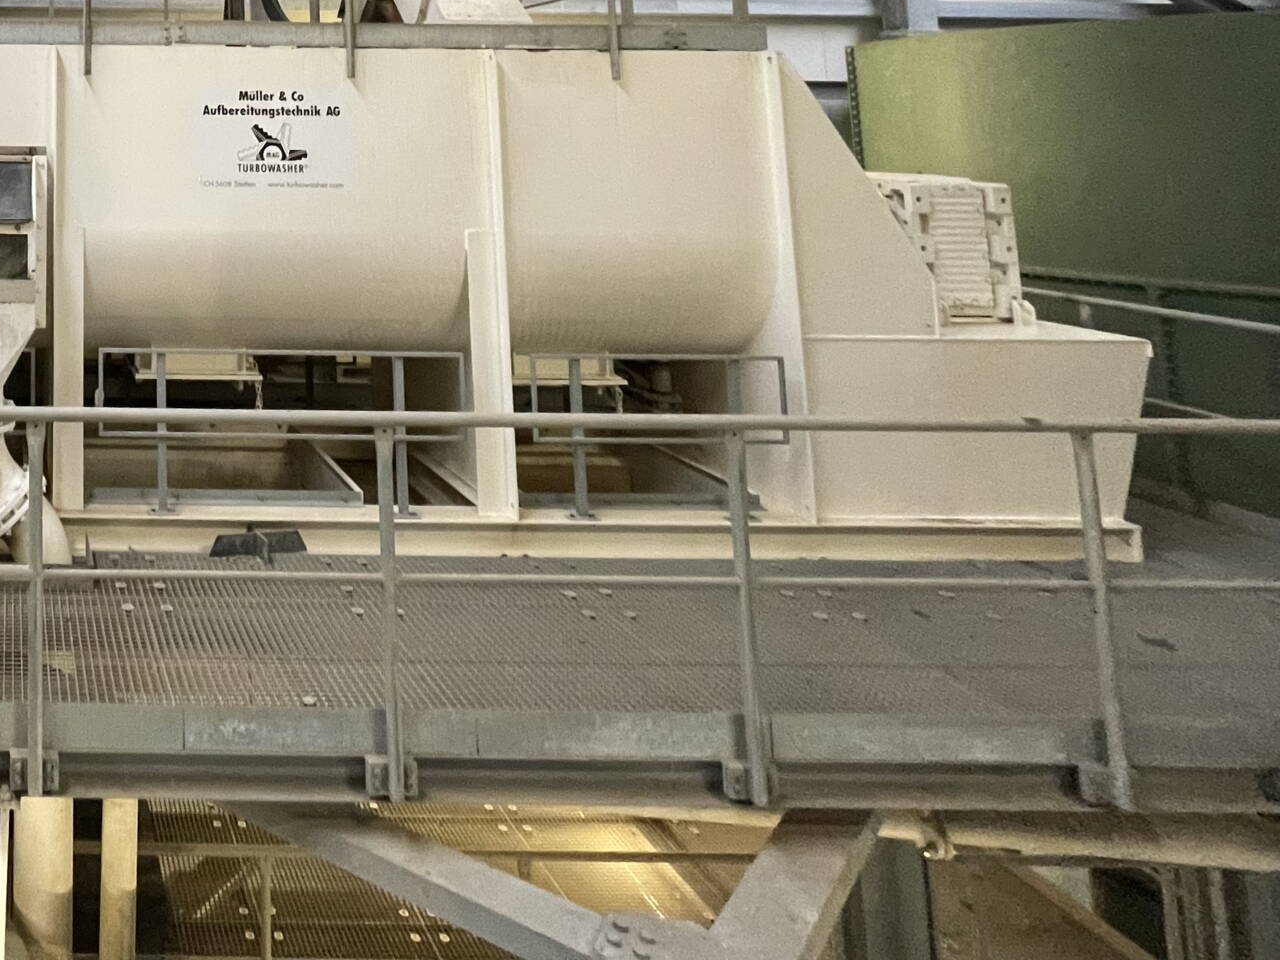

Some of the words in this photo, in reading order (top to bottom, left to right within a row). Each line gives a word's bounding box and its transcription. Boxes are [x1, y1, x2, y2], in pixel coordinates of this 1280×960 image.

[238, 90, 274, 102] Müller
[279, 91, 287, 102] &
[291, 91, 304, 102] Co
[203, 105, 321, 118] Aufbereitungstechnik
[326, 106, 341, 117] AG
